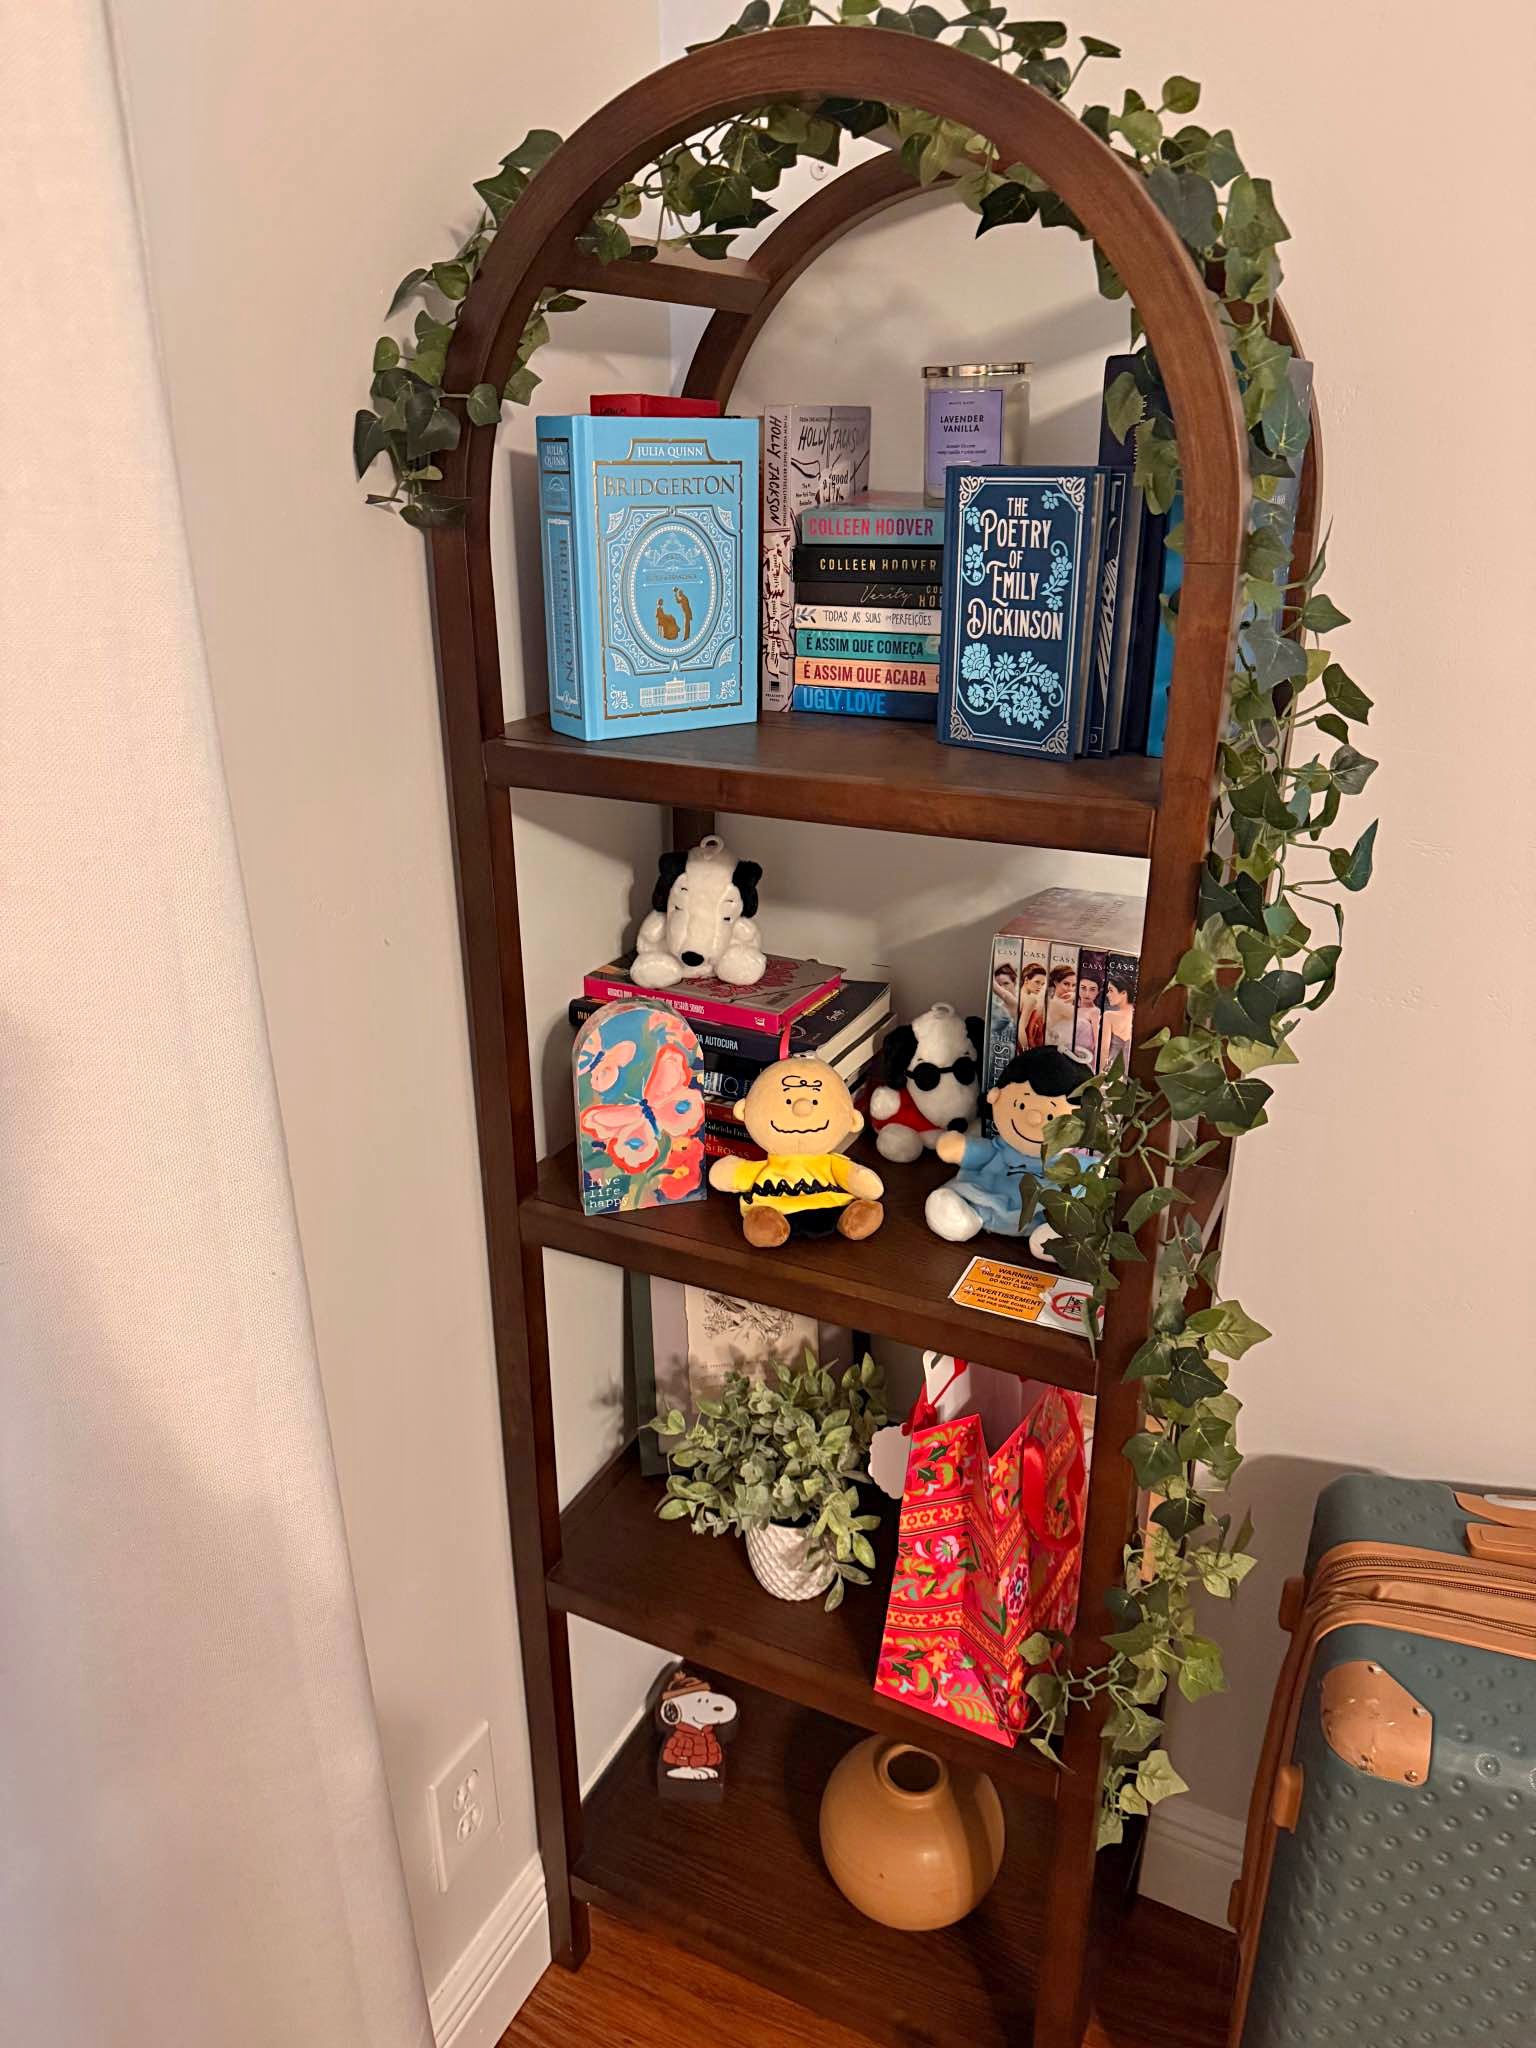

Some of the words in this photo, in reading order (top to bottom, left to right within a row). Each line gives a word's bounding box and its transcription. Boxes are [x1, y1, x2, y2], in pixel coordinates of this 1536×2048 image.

[940, 414, 984, 423] LAVENDER
[943, 424, 980, 433] VANILLA
[767, 415, 781, 459] HOLLY
[798, 425, 830, 455] HOLLY
[546, 445, 564, 456] JULIA
[637, 446, 665, 457] JULIA
[667, 446, 704, 458] QUINN
[545, 455, 567, 467] QUINN
[603, 475, 735, 496] BRIDGERTON
[767, 462, 781, 526] JACKSON
[1007, 497, 1029, 516] THE
[808, 517, 870, 537] COLLEEN
[875, 517, 933, 537] HOOVER
[980, 509, 1052, 551] POETRY
[820, 558, 876, 570] COLLEEN
[881, 559, 936, 571] HOOVER
[1009, 550, 1024, 569] OF
[986, 560, 1040, 607] EMILY
[860, 583, 912, 607] Verity
[824, 609, 848, 623] TODAS
[852, 611, 861, 624] AS
[865, 611, 881, 624] SUAS
[967, 597, 1064, 640] DICKINSON
[806, 634, 813, 650] É
[815, 637, 849, 652] ASSIM
[852, 639, 873, 654] QUE
[877, 640, 924, 660] COMEÇA
[803, 660, 811, 679] É
[814, 664, 853, 682] ASSIM
[857, 667, 881, 684] QUE
[884, 668, 927, 686] ACABA
[803, 687, 841, 711] UGLY
[846, 690, 887, 714] LOVE
[1023, 951, 1047, 959] CASS
[1082, 962, 1103, 971] CASS
[1109, 961, 1135, 971] CASS
[704, 1035, 738, 1050] AUTOCURA
[590, 1178, 620, 1187] live
[590, 1187, 620, 1198] life
[590, 1198, 627, 1208] happy
[998, 1268, 1039, 1281] WARNING
[1013, 1283, 1032, 1291] CLIMB
[976, 1286, 1042, 1306] AVERTISSEMENT
